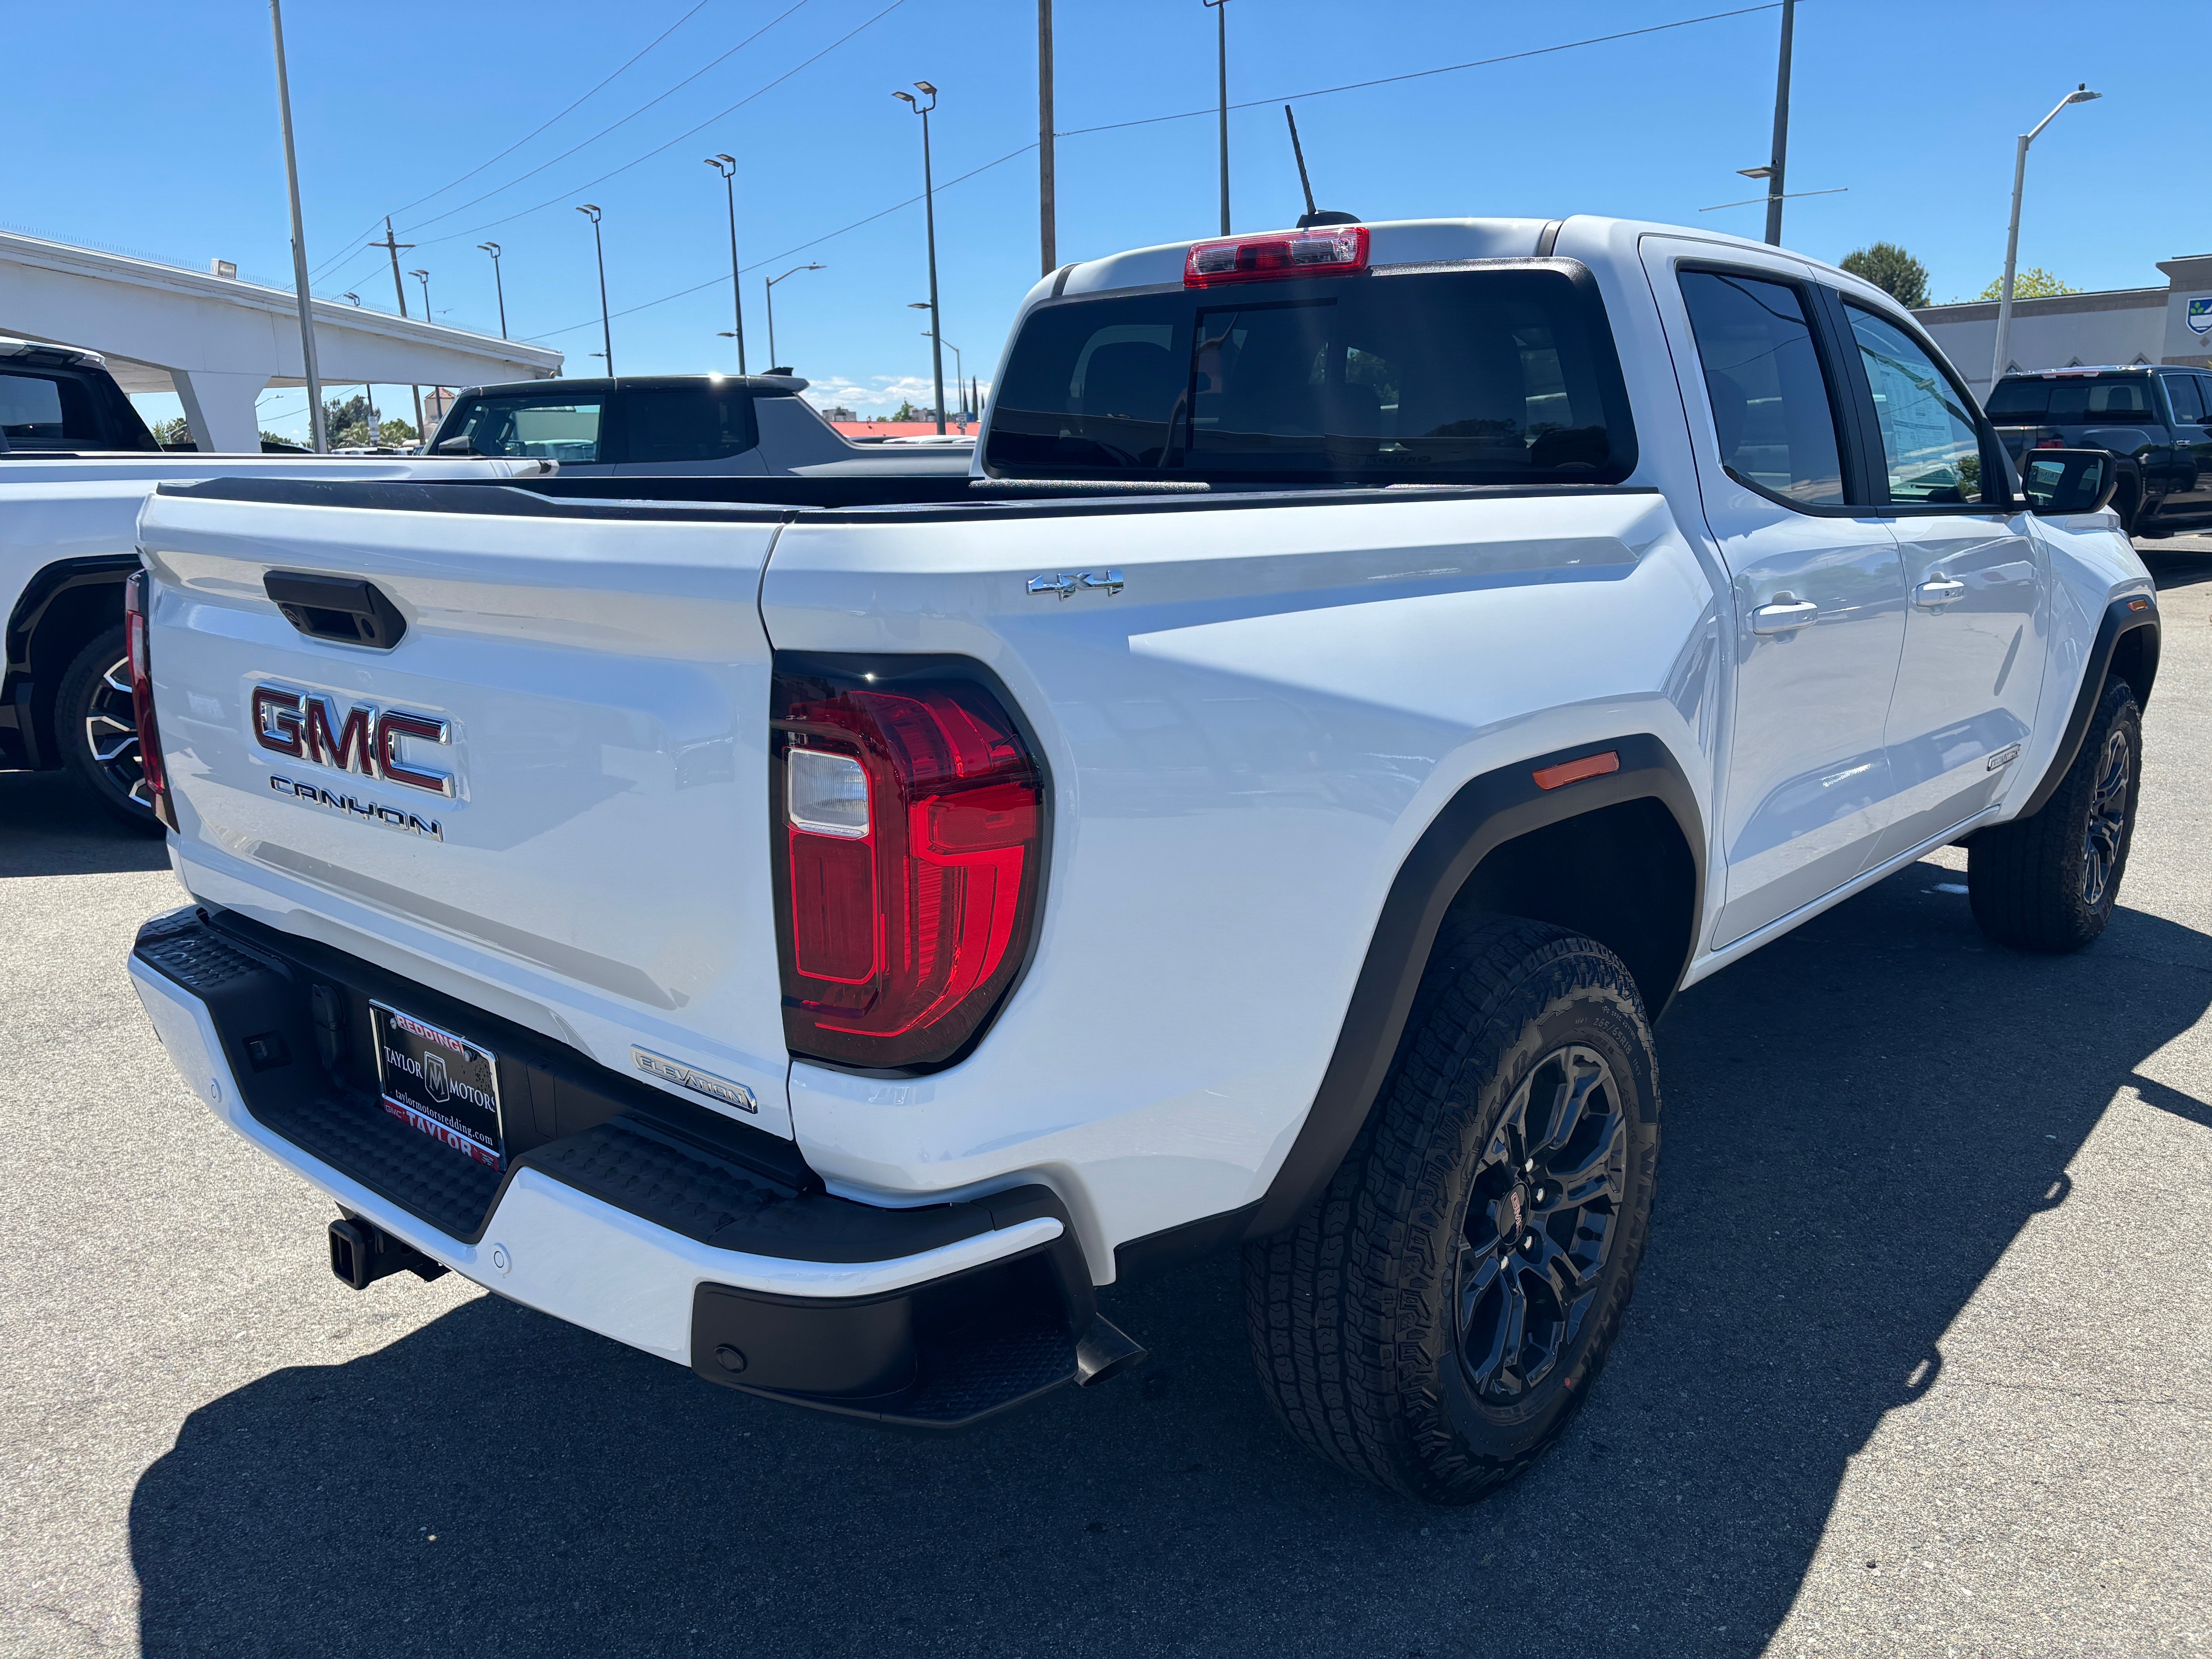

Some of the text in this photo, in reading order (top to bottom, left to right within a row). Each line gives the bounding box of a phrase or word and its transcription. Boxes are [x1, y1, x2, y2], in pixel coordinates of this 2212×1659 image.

[252, 683, 456, 799] GMC
[270, 774, 444, 842] CANYON
[397, 1015, 461, 1052] REDDING
[1592, 1017, 1633, 1054] 265/65R18
[384, 1046, 496, 1113] TAYLOR MOTORS
[639, 1056, 744, 1104] ELEVATION
[385, 1105, 402, 1119] GMC
[395, 1089, 493, 1146] taylormotorsredding.com
[407, 1111, 472, 1158] TAYLOR
